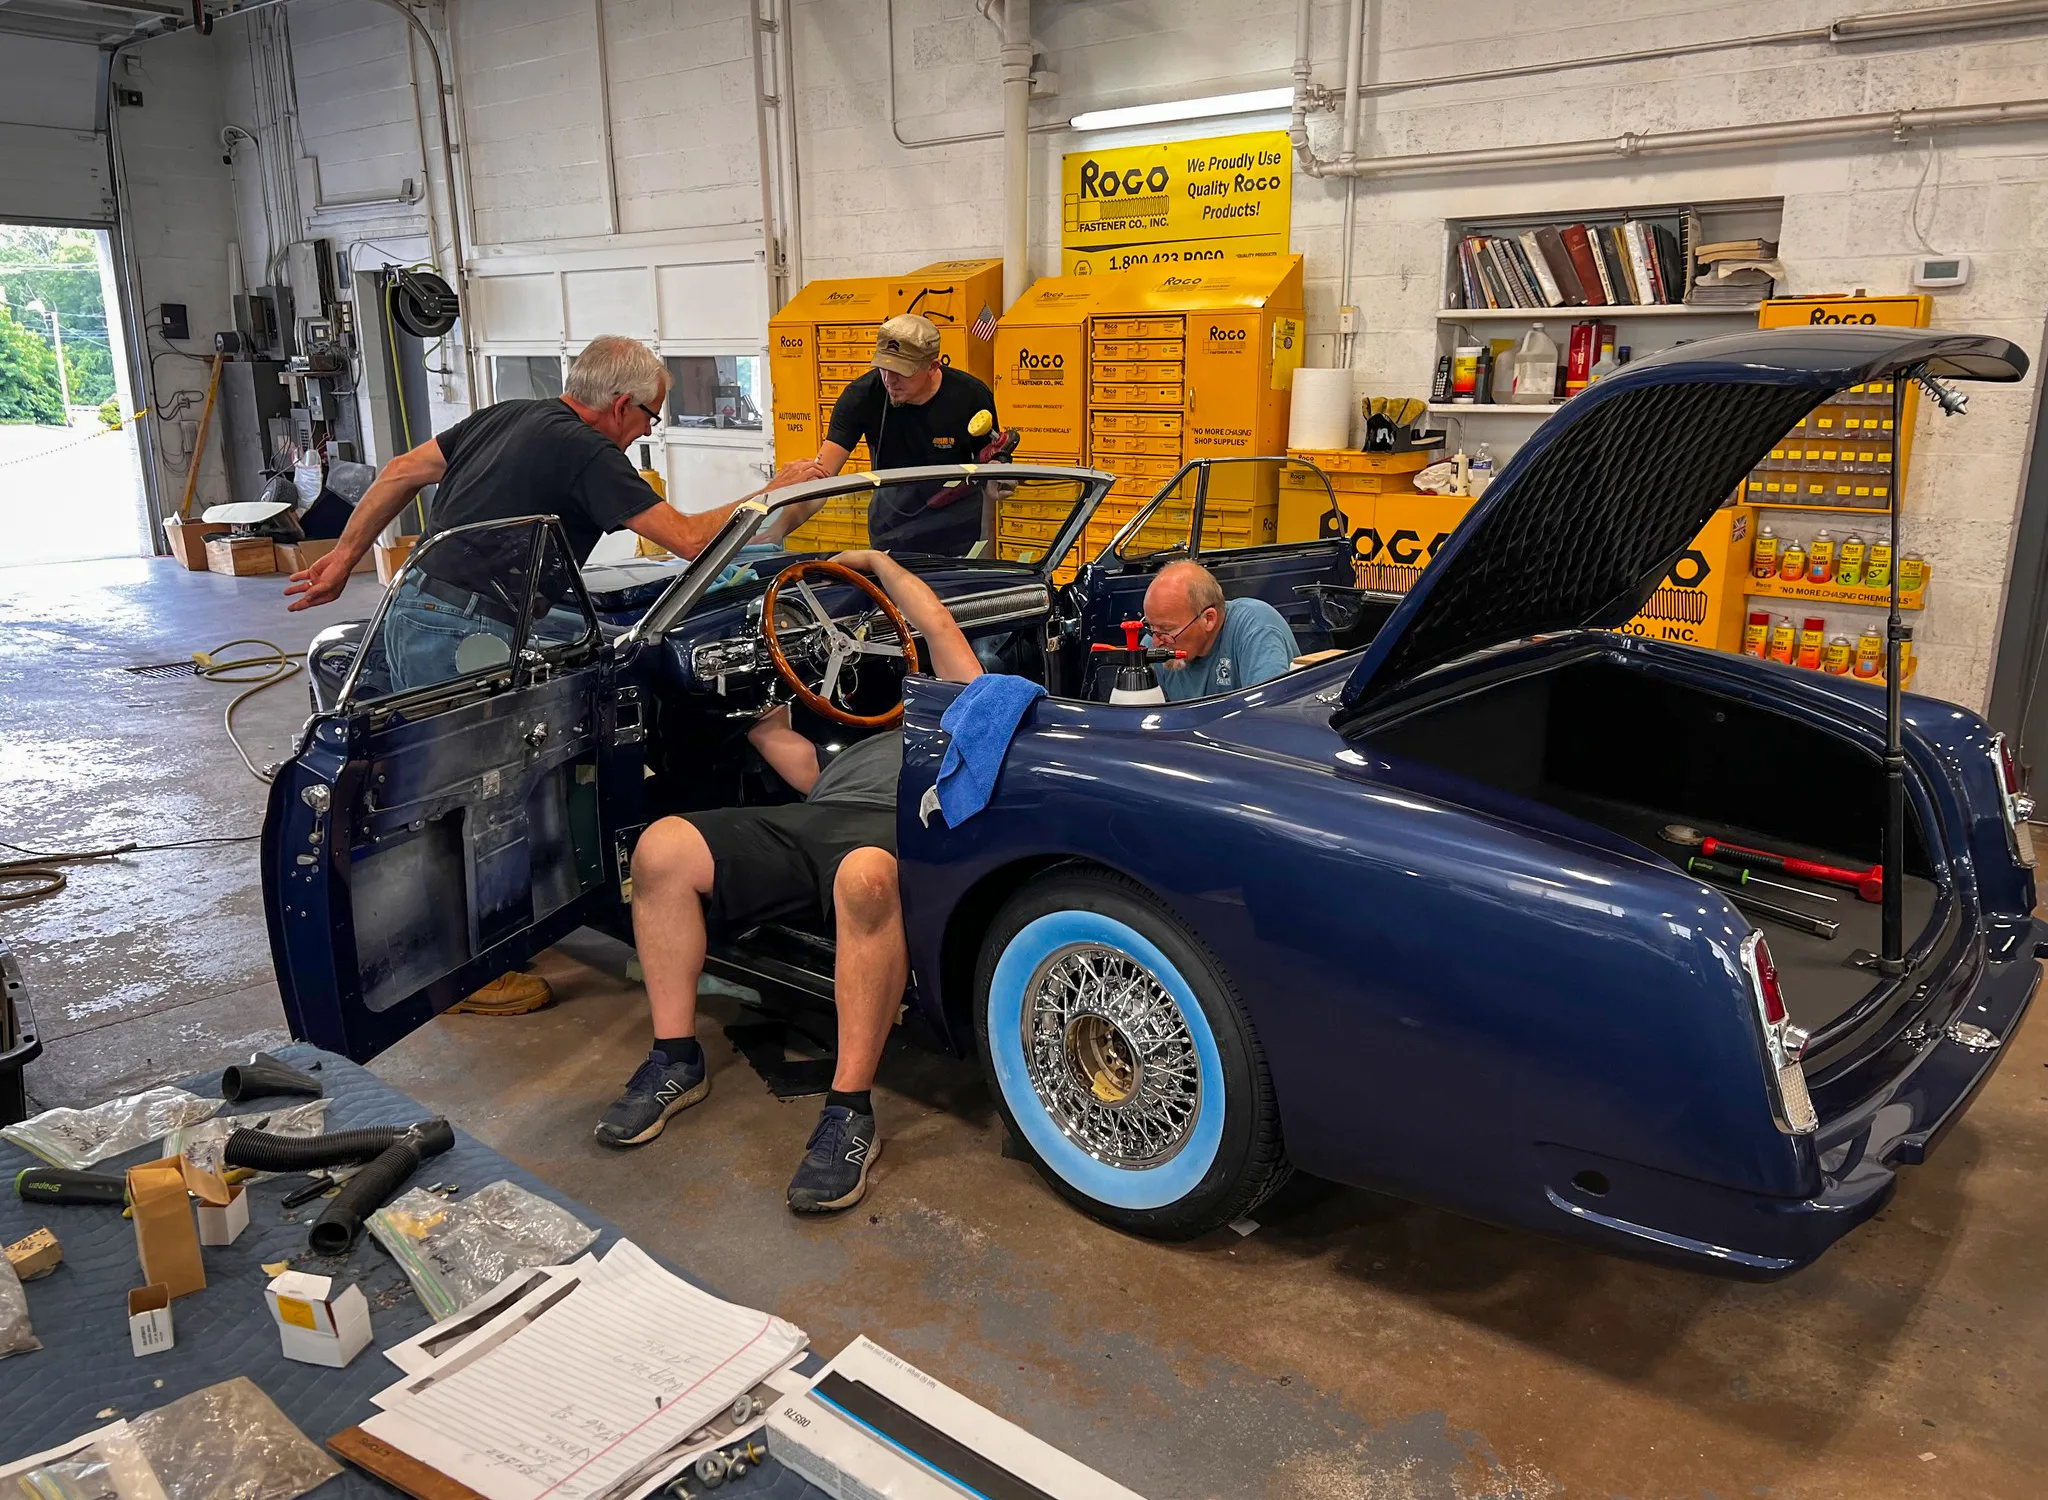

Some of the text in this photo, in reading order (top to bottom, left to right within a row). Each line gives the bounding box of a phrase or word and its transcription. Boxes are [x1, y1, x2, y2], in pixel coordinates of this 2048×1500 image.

[1187, 150, 1281, 173] We Proudly Use
[1080, 159, 1169, 199] ROGO
[1187, 173, 1281, 199] Quality ROGO
[1202, 201, 1260, 220] Products!
[1080, 217, 1169, 232] FASTENER CO., INC.
[1163, 276, 1202, 286] ROGO
[1809, 307, 1876, 326] ROGO
[1210, 325, 1246, 340] ROGO
[780, 335, 803, 347] ROGO
[1019, 348, 1064, 368] ROGO
[778, 412, 811, 420] AUTOMOTIVE
[787, 424, 804, 432] TAPES
[1224, 428, 1252, 436] CHASING
[1796, 588, 1821, 597] MORE
[1821, 590, 1856, 600] CHASING
[1662, 626, 1698, 643] INC.
[783, 1407, 812, 1428] 08578
